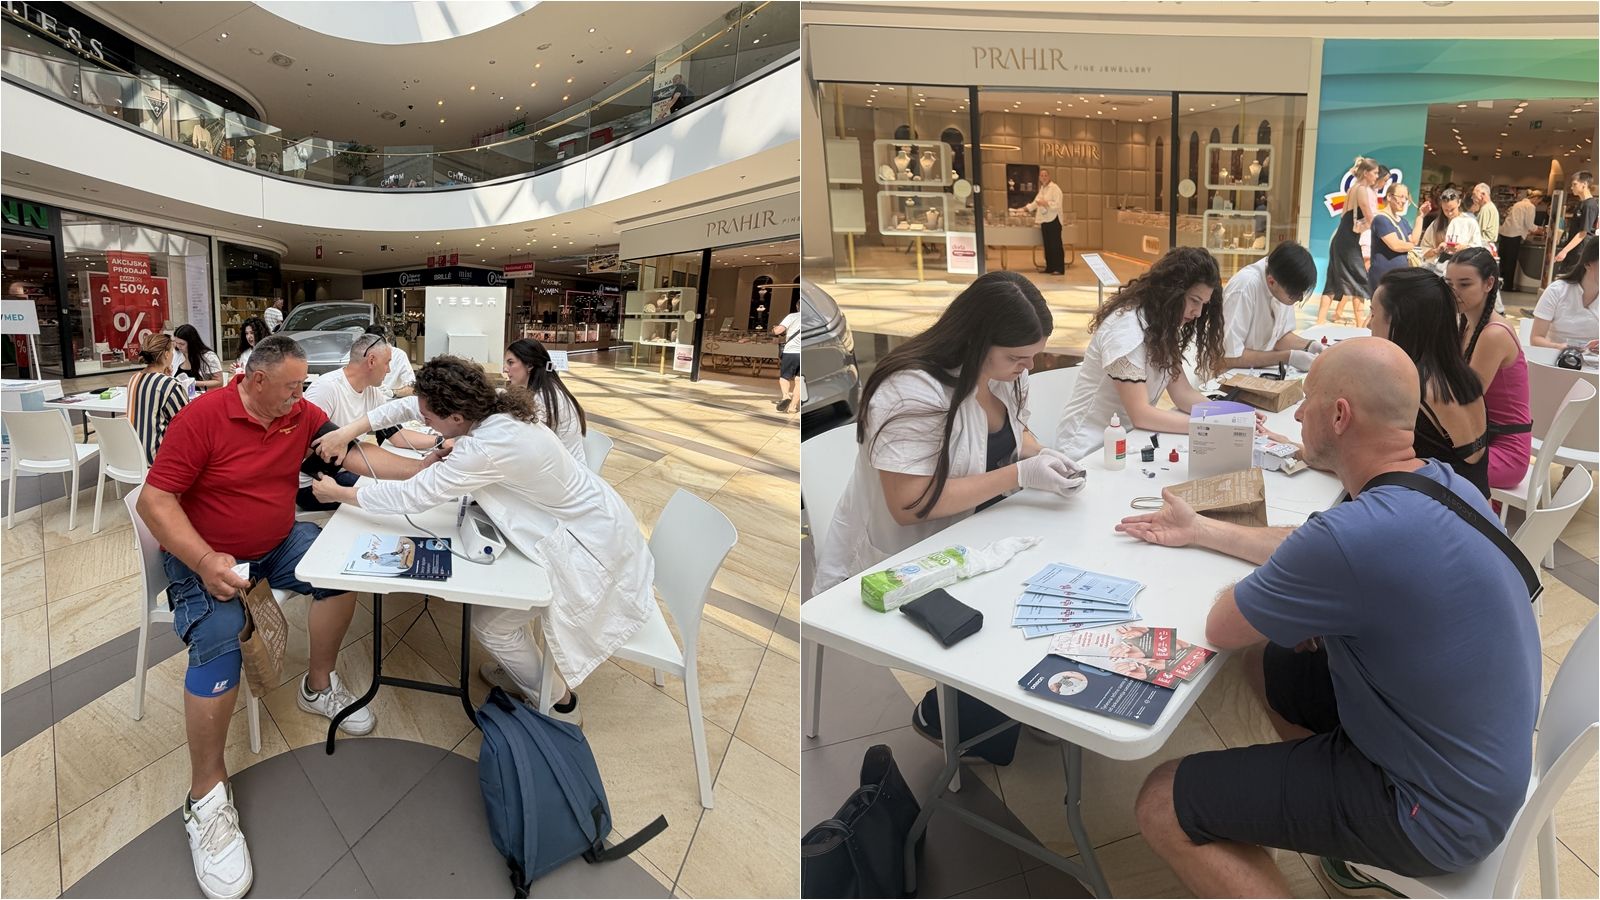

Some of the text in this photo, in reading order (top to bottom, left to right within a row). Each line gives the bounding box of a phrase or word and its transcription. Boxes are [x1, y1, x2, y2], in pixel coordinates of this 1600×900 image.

[972, 46, 1069, 71] PRAHIR
[1042, 143, 1101, 160] PRAHIR
[706, 209, 779, 238] PRAHIR
[111, 258, 148, 268] AKCIJSKA
[112, 266, 148, 275] PRODAJA
[112, 283, 150, 295] -50%
[435, 296, 497, 306] TESLA
